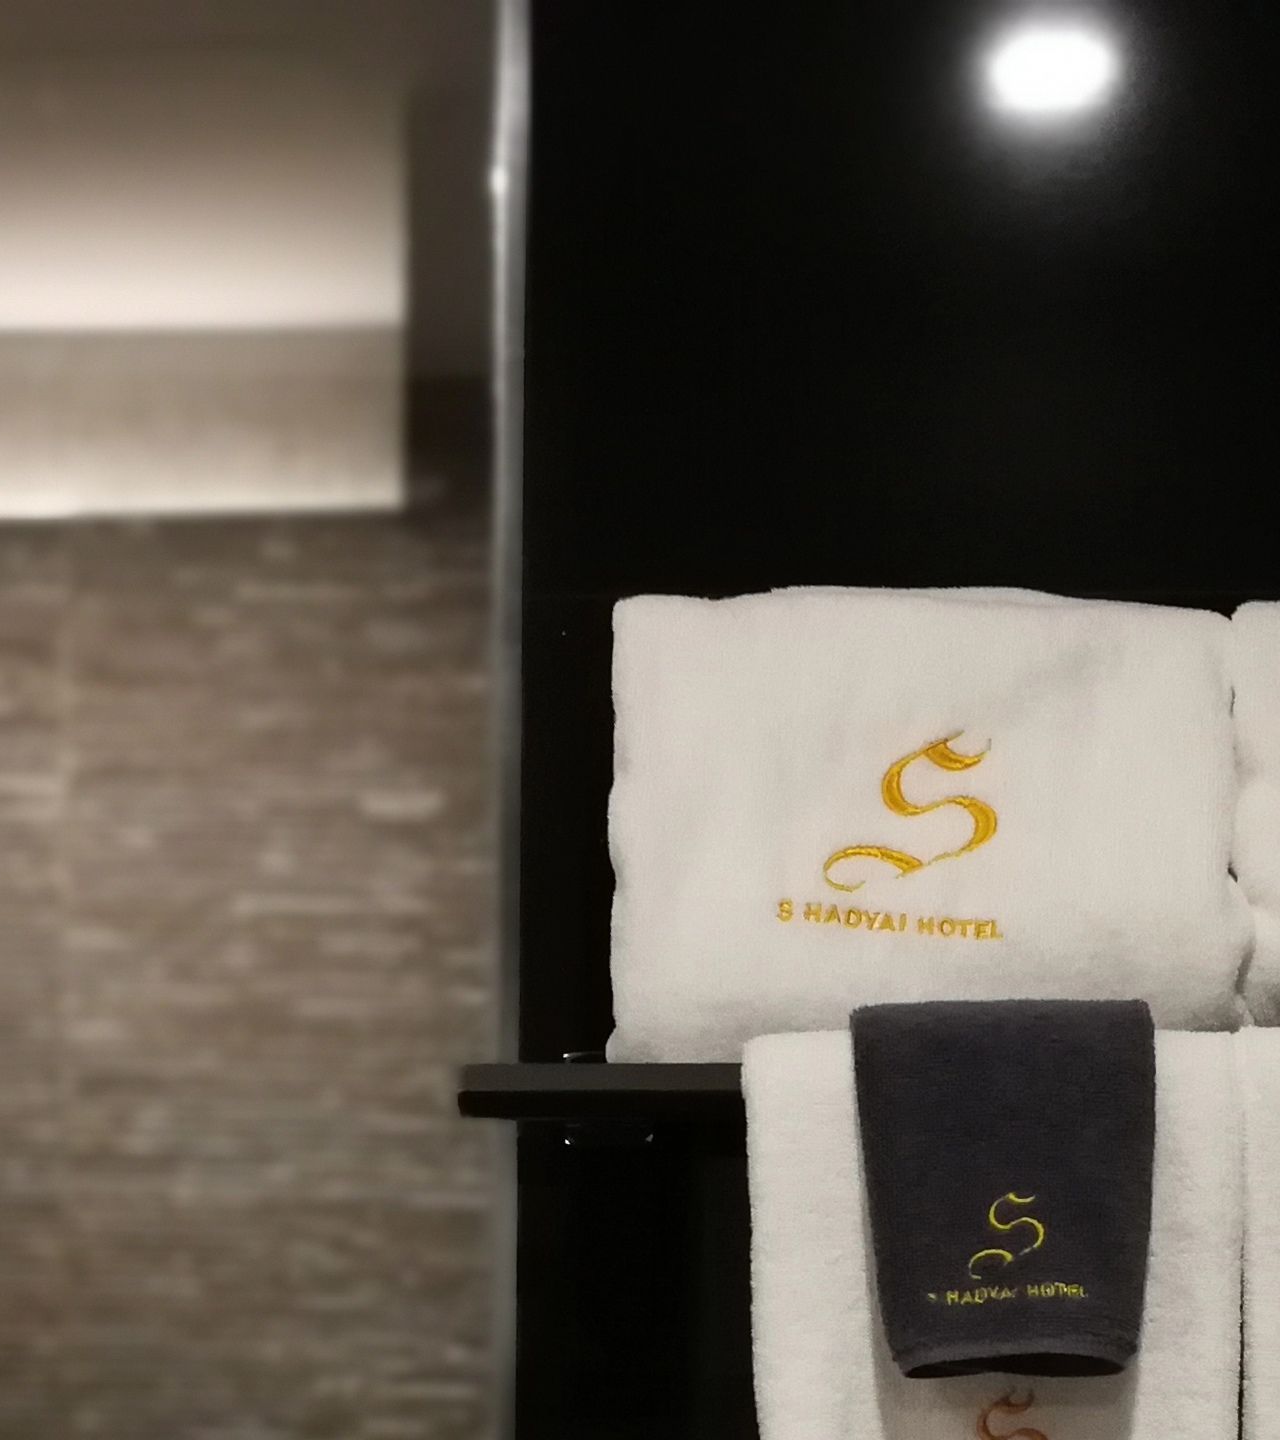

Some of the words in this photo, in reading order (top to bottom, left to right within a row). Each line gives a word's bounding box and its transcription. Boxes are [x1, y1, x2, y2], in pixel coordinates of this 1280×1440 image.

[822, 729, 998, 891] S
[777, 899, 793, 922] S
[803, 902, 908, 931] HADYAI
[918, 917, 1003, 940] HOTEL
